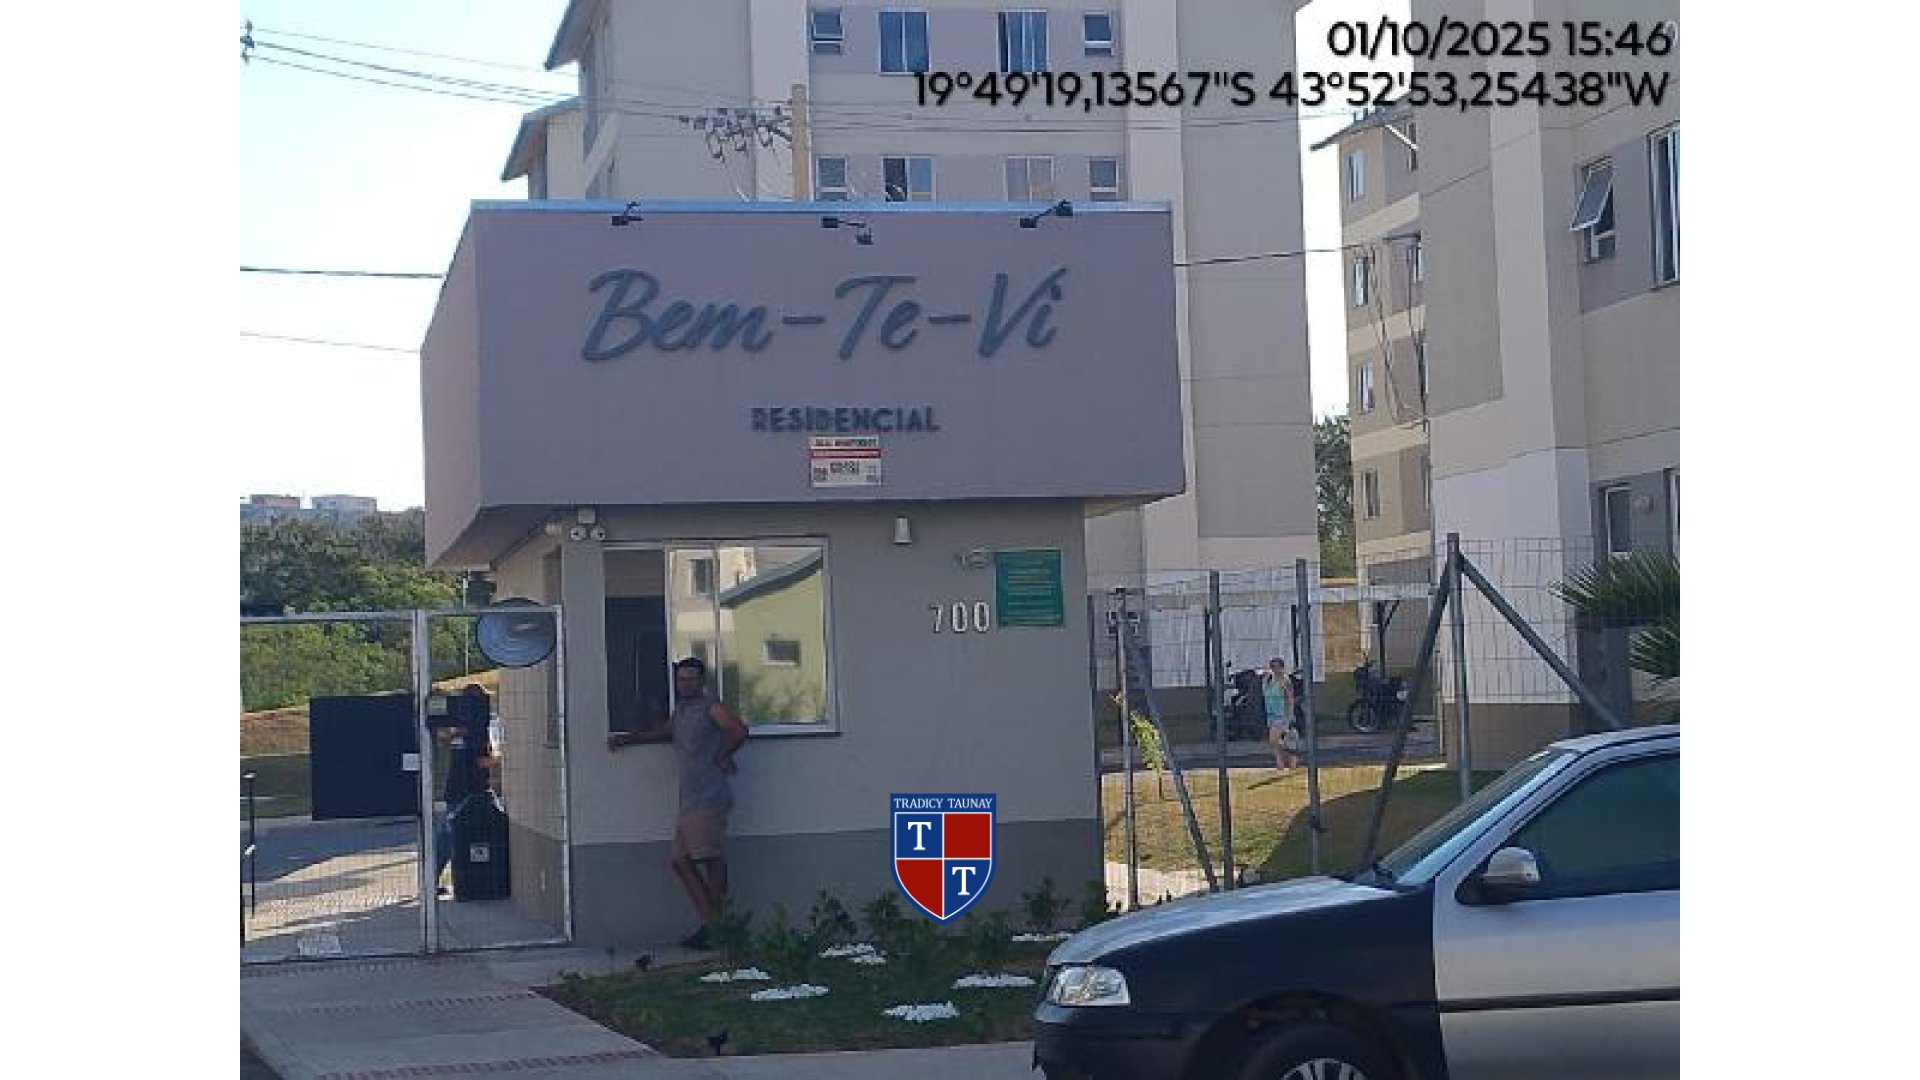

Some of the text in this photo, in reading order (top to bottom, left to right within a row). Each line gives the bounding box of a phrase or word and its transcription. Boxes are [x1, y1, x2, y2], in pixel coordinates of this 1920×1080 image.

[582, 267, 1067, 362] Bem-Te-Vi
[751, 405, 941, 433] RESIDENCIAL
[930, 600, 991, 634] 700
